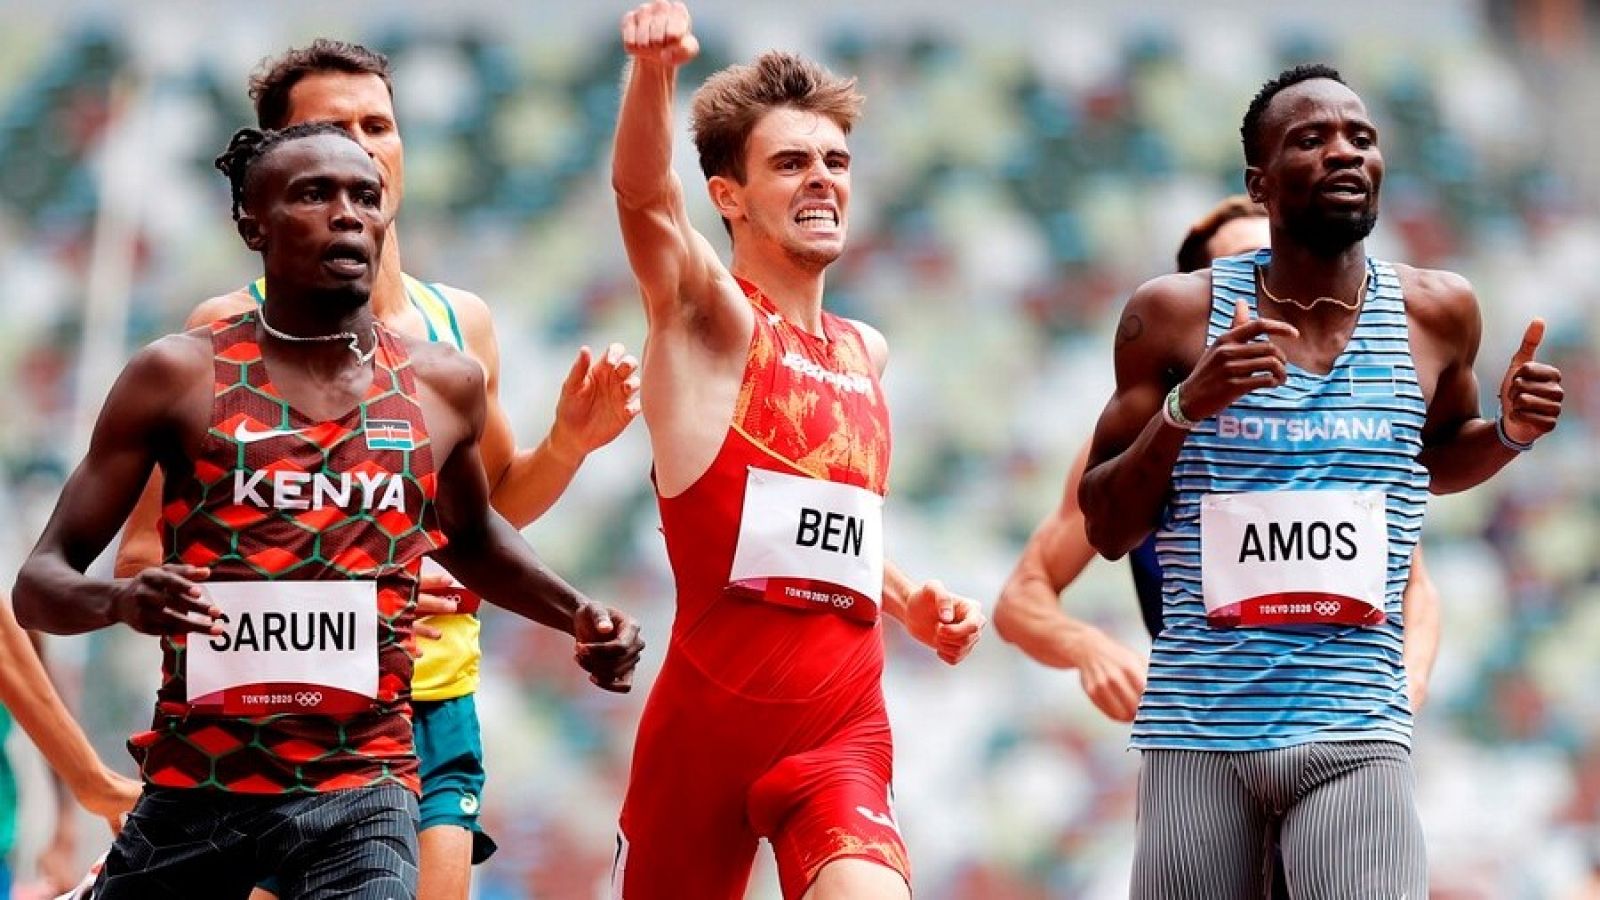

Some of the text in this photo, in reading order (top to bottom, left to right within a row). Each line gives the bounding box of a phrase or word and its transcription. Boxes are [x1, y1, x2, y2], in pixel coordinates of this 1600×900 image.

[1218, 415, 1393, 442] BOTSWANA
[233, 469, 406, 513] KENYA
[796, 507, 864, 557] BEN
[1238, 521, 1358, 563] AMOS
[785, 586, 830, 602] TOKYO 2020
[1259, 604, 1312, 614] TOKYO 2020
[209, 611, 356, 652] SARUNI
[241, 694, 293, 704] TOKYO 2020
